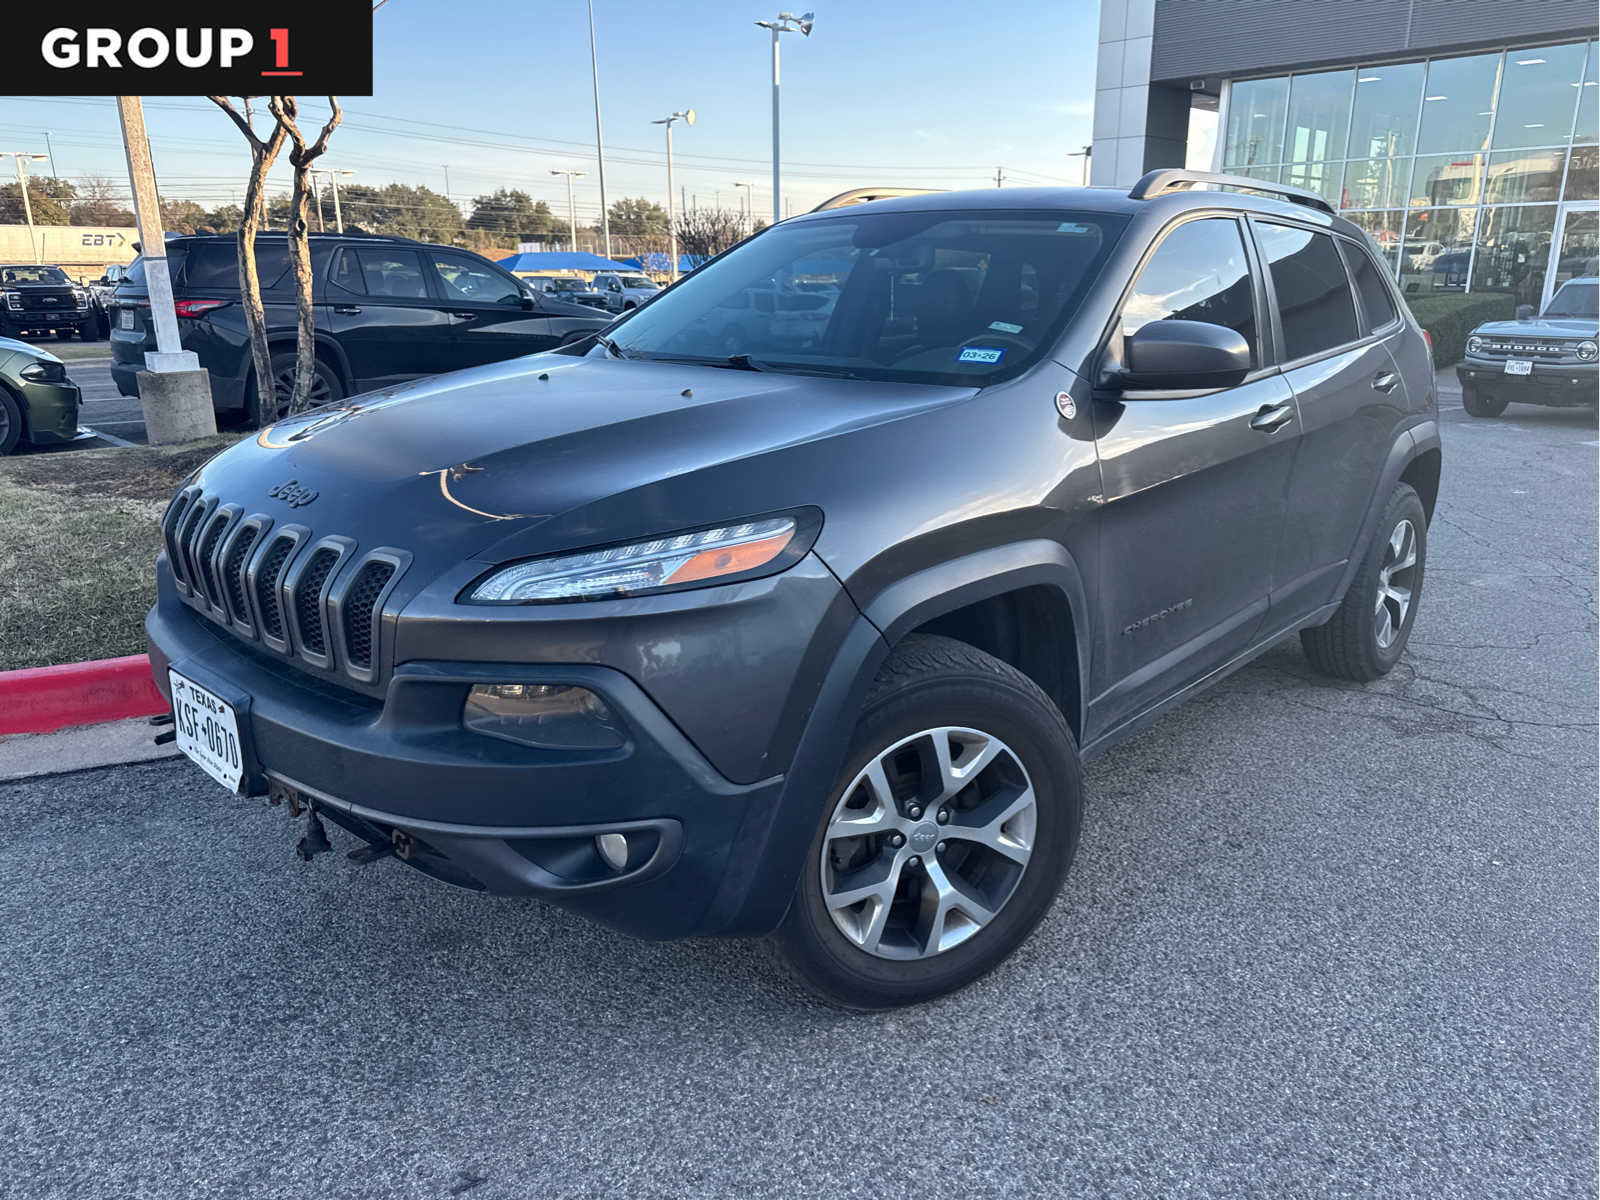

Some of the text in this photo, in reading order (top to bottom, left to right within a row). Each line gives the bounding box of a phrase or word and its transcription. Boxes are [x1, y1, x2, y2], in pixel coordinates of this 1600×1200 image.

[82, 233, 116, 247] EBT
[1492, 344, 1560, 352] BRONCO
[268, 479, 319, 509] Jeep
[1121, 598, 1192, 634] CHEROKEE
[189, 686, 217, 714] TEXAS
